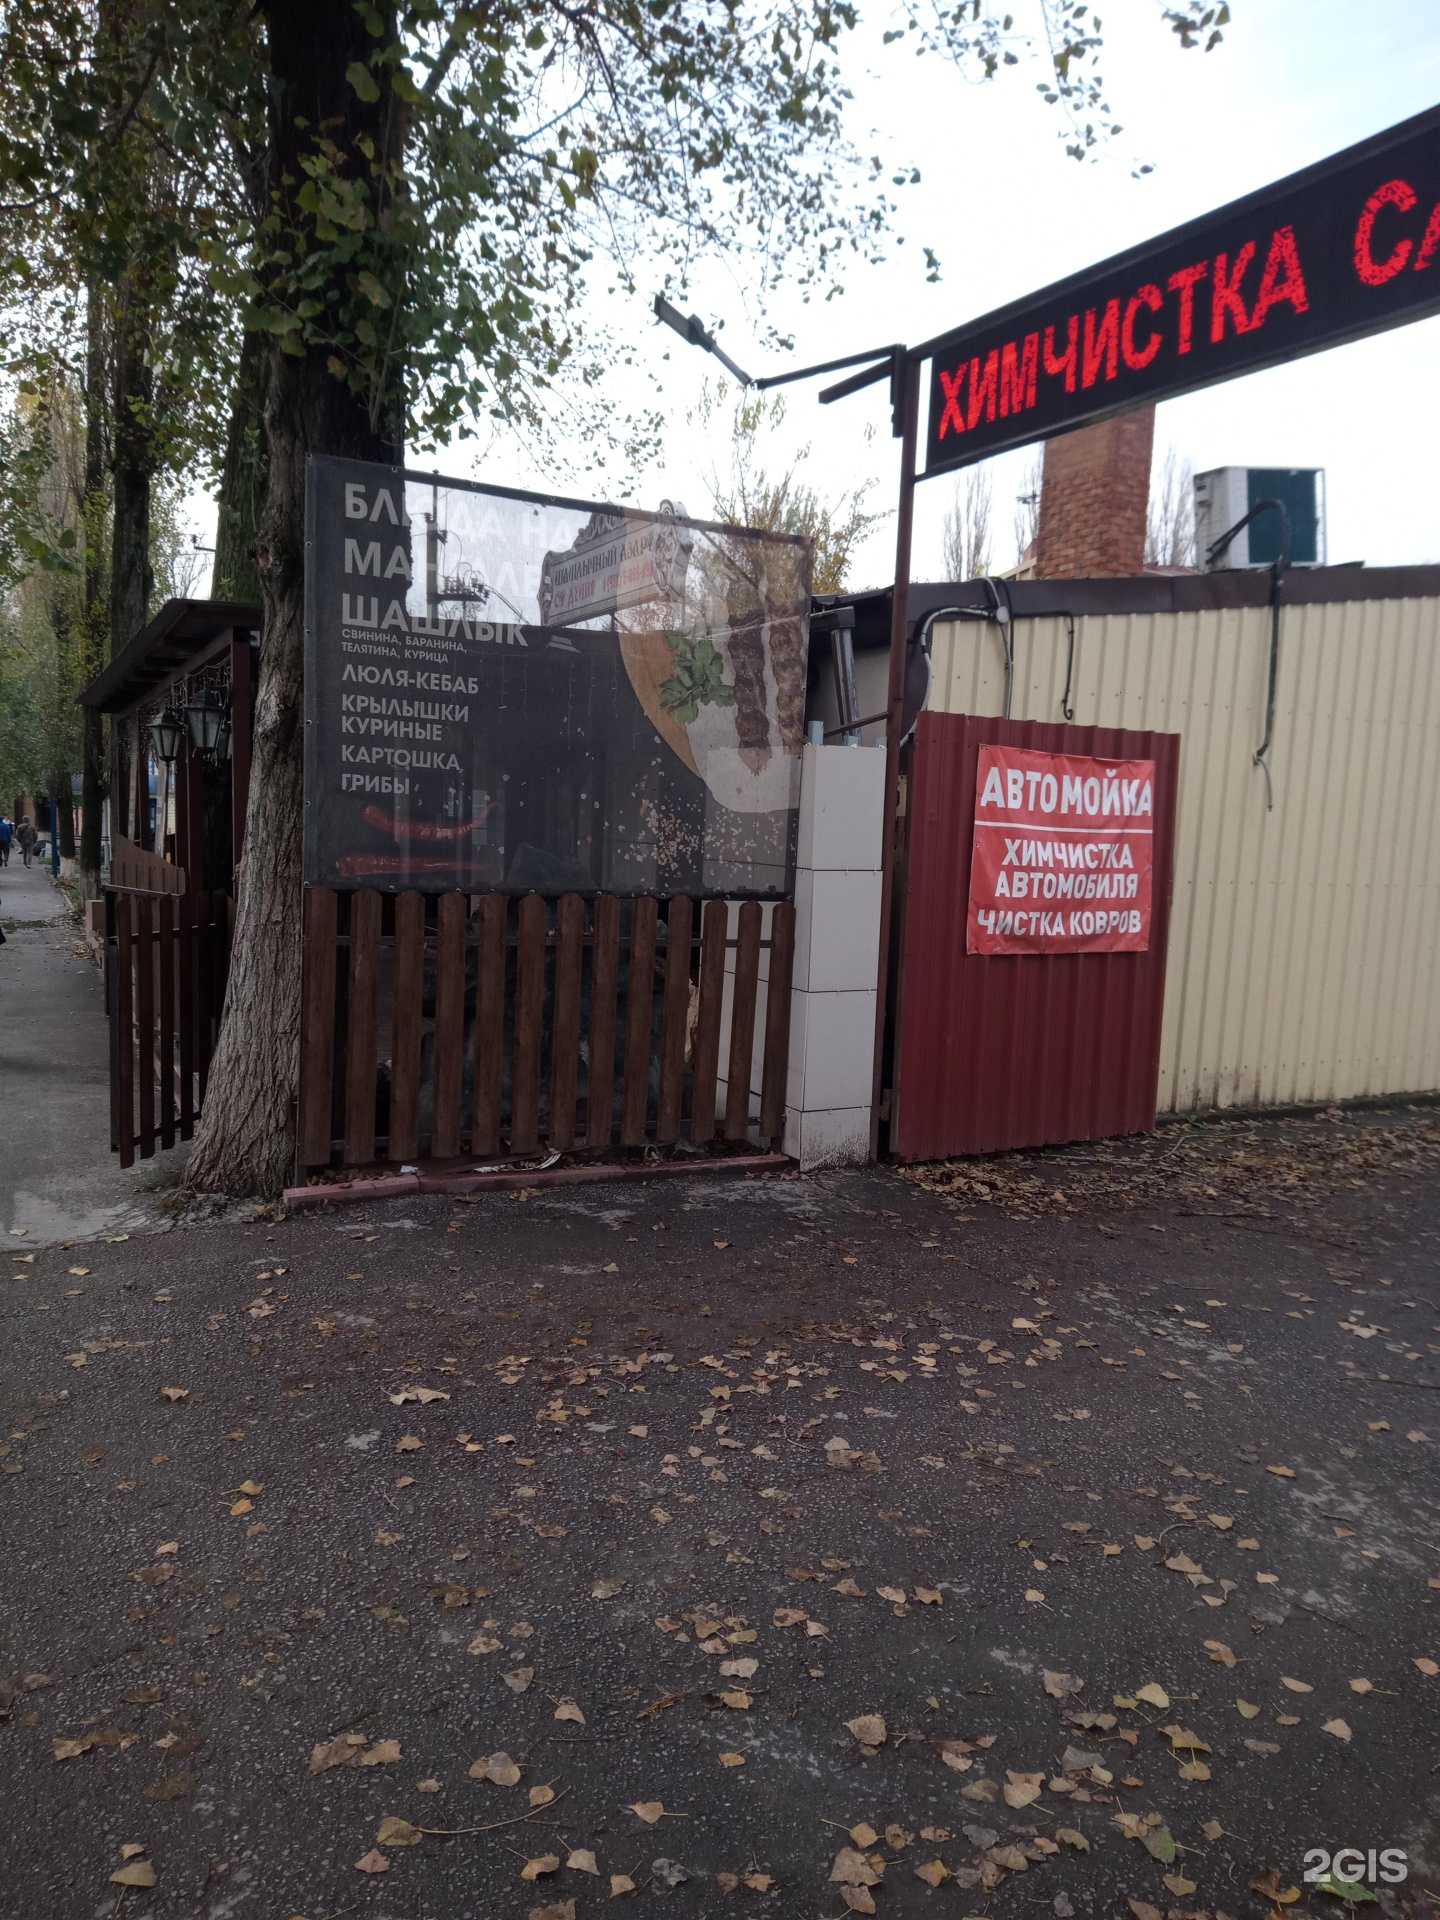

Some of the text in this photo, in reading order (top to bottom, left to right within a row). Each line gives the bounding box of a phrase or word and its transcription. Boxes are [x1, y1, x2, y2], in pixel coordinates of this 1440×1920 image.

[939, 225, 1309, 440] ХИМЧИСТКА
[341, 642, 448, 664] ТЕЛЯТИНА, КУРИЦА
[342, 628, 468, 654] СВИНИНА, БАРАНИНА,
[342, 664, 479, 694] ЛЮЛЯ-КЕБАБ
[341, 694, 469, 722] КРЫЛЫШКИ
[341, 716, 442, 741] КУРИНЫЕ
[341, 745, 464, 773] КАРТОШКА,
[341, 774, 410, 795] ГРИБЫ
[980, 767, 1152, 816] АВТОМОЙКА
[1002, 839, 1134, 869] ХИМЧИСТКА
[994, 871, 1138, 899] АВТОМОБИЛЯ
[978, 909, 1142, 936] ЧИСТКА КОВРОВ
